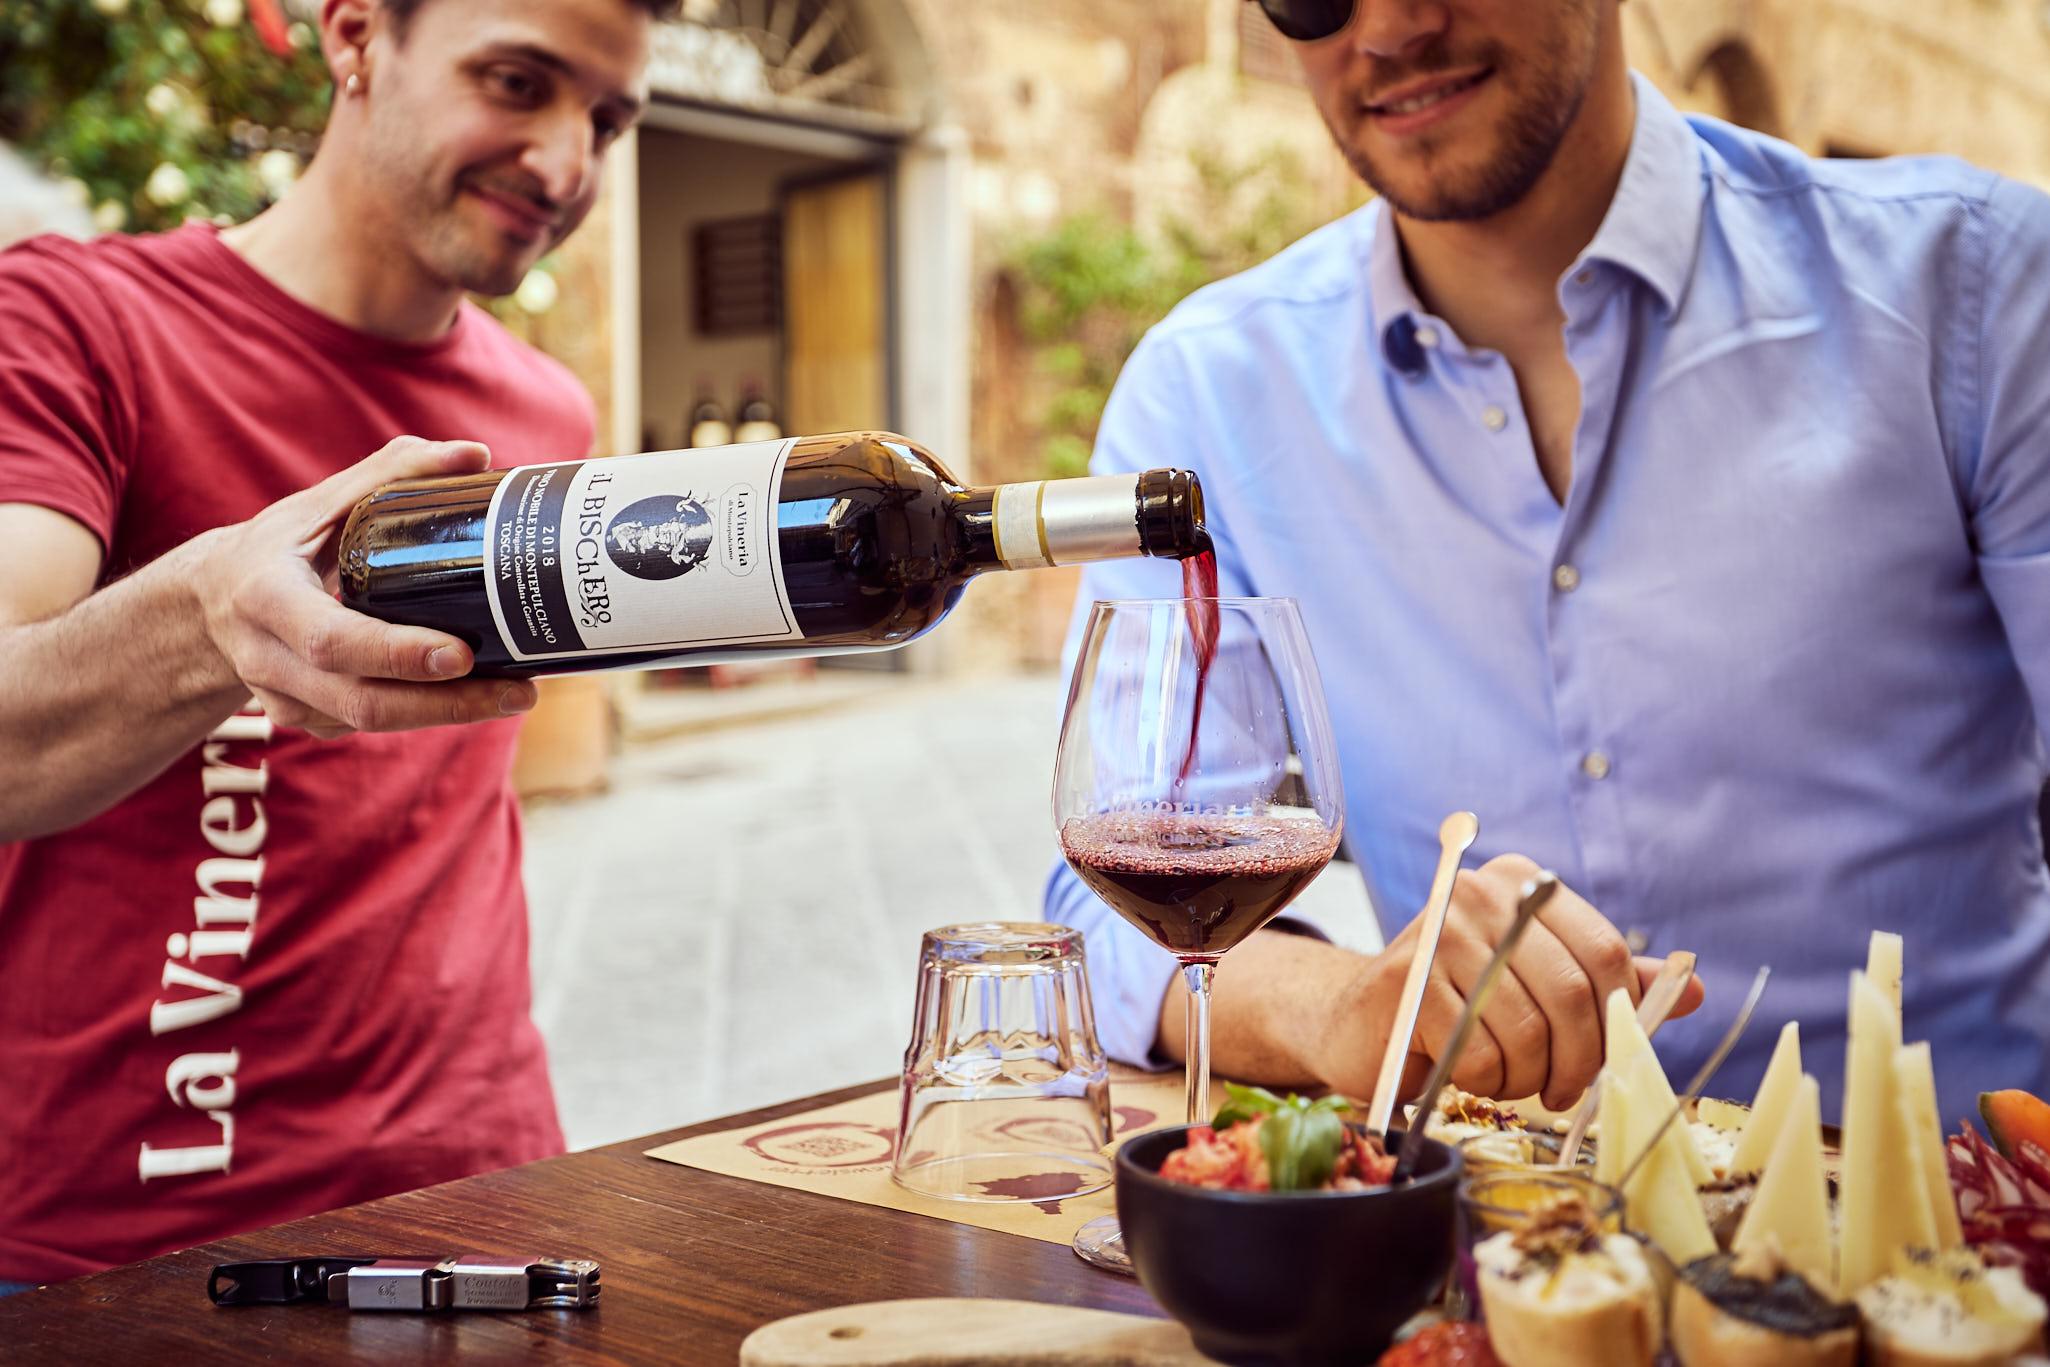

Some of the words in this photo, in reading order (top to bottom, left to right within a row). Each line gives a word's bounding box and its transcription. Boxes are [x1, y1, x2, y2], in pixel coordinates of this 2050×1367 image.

[517, 474, 541, 516] Denominazione
[537, 468, 558, 488] VINO
[515, 516, 524, 525] di
[526, 485, 546, 525] NOBILE
[738, 492, 749, 508] La
[500, 520, 512, 580] TOSCANA
[512, 525, 524, 555] Origine
[525, 526, 537, 540] DI
[541, 525, 555, 567] 2018
[737, 511, 749, 567] Vineria
[514, 555, 527, 600] Controllata
[525, 541, 557, 644] MONTEPULCIANO
[522, 606, 538, 637] Garantita
[150, 694, 273, 1036] Vineri
[138, 1047, 241, 1184] La
